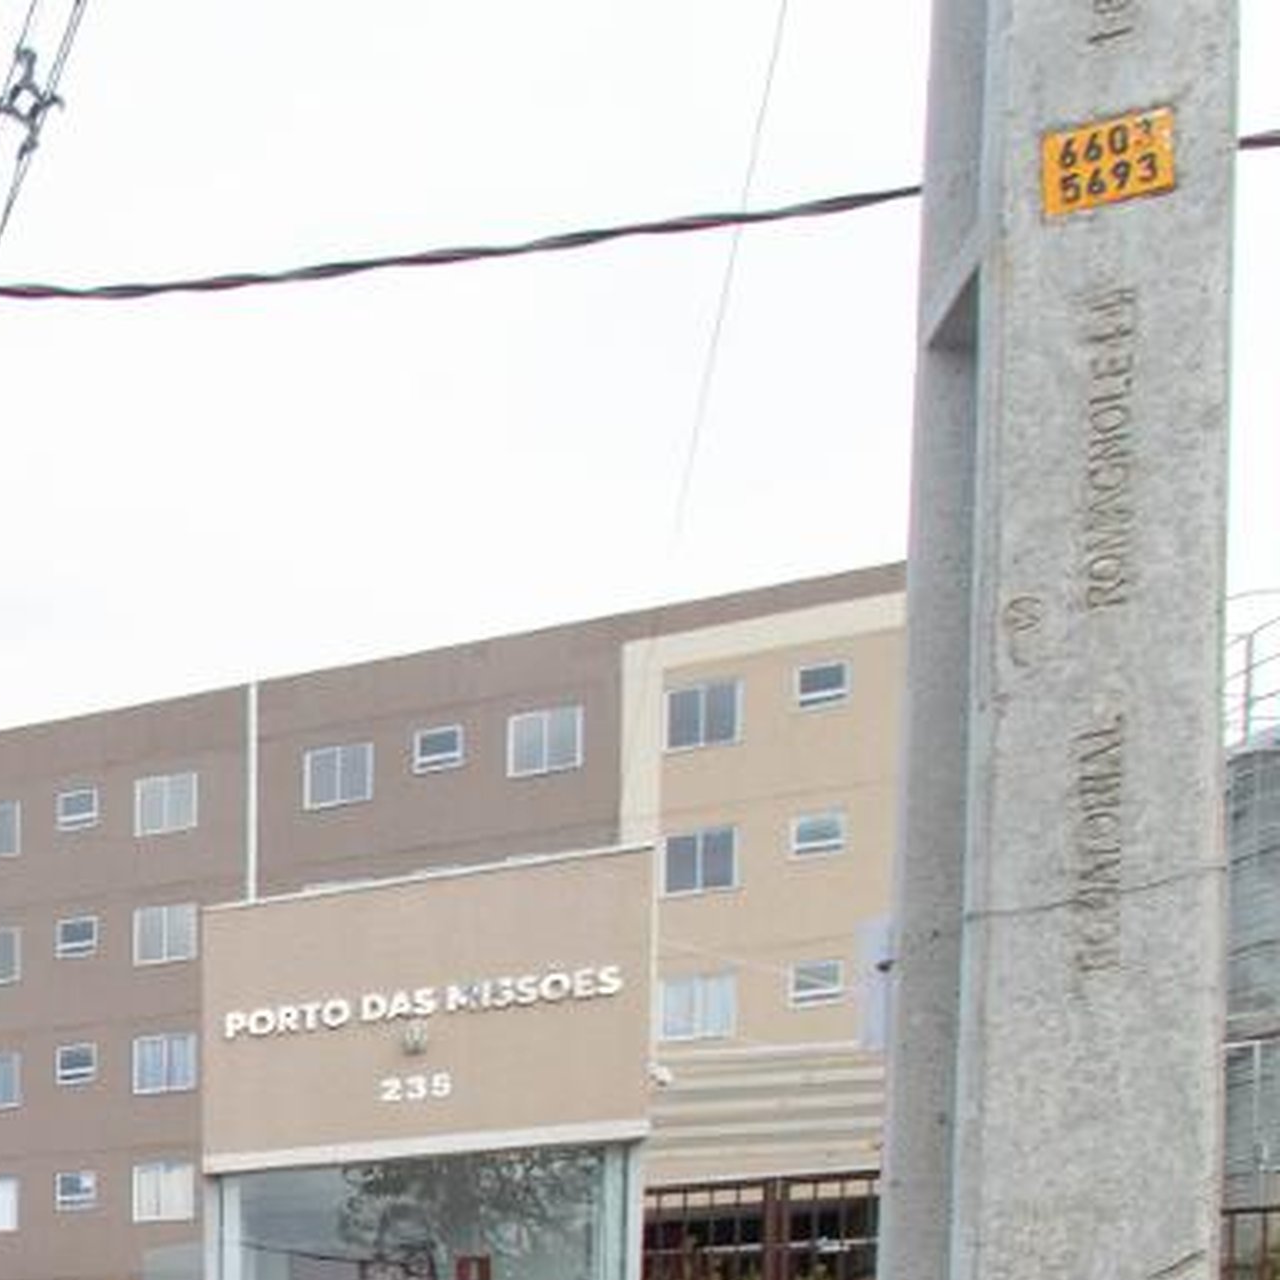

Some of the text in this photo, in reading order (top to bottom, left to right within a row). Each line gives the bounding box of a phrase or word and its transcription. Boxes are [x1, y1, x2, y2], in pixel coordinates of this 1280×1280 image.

[1062, 153, 1158, 204] 5693
[224, 998, 351, 1039] PORTO
[361, 988, 437, 1020] DAS
[380, 1072, 452, 1101] 235
